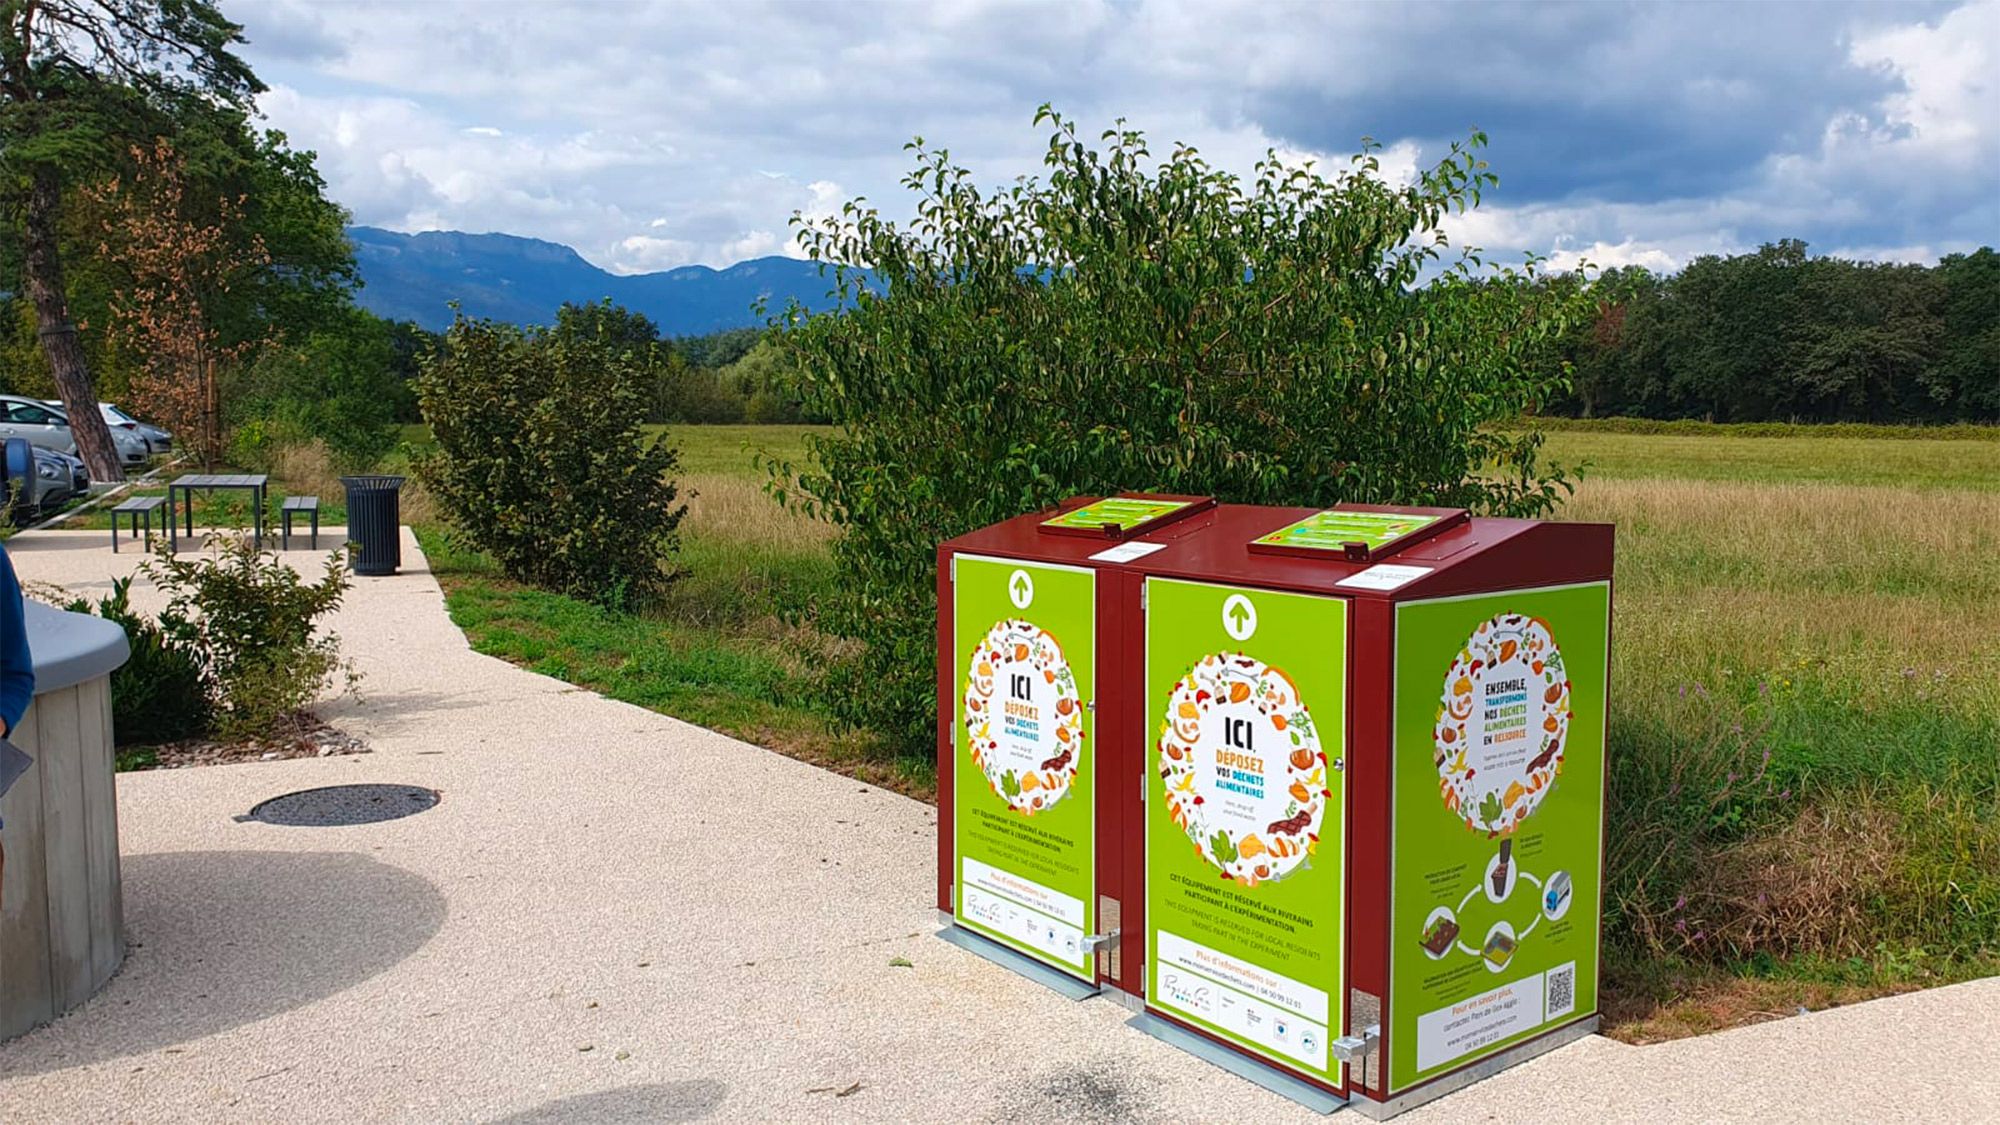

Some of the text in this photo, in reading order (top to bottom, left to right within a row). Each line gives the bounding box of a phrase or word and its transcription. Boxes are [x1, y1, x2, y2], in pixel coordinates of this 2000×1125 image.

[1485, 678, 1527, 696] ENSEMBLE,
[1005, 700, 1039, 720] DÉPOSEZ
[1485, 693, 1527, 707] TRANSFORMONS
[1005, 715, 1015, 725] VOS
[1485, 704, 1527, 720] NOS DÉCHETS
[1225, 716, 1256, 753] ICI,
[1485, 717, 1527, 732] ALIMENTAIRES
[1484, 729, 1526, 745] EN RESSOURCE
[1216, 748, 1264, 774] DÉPOSEZ
[1216, 765, 1264, 787] VOS DÉCHETS
[1216, 779, 1264, 799] ALIMENTAIRES
[1170, 873, 1314, 928] CET ÉQUIPEMENT EST RÉSERVÉ AUX RIVERAINS
[1184, 889, 1223, 910] PARTICIPANT
[1195, 950, 1210, 965] Plus
[1452, 1002, 1467, 1016] Pour
[1468, 1001, 1477, 1010] en
[1478, 995, 1497, 1007] savoir
